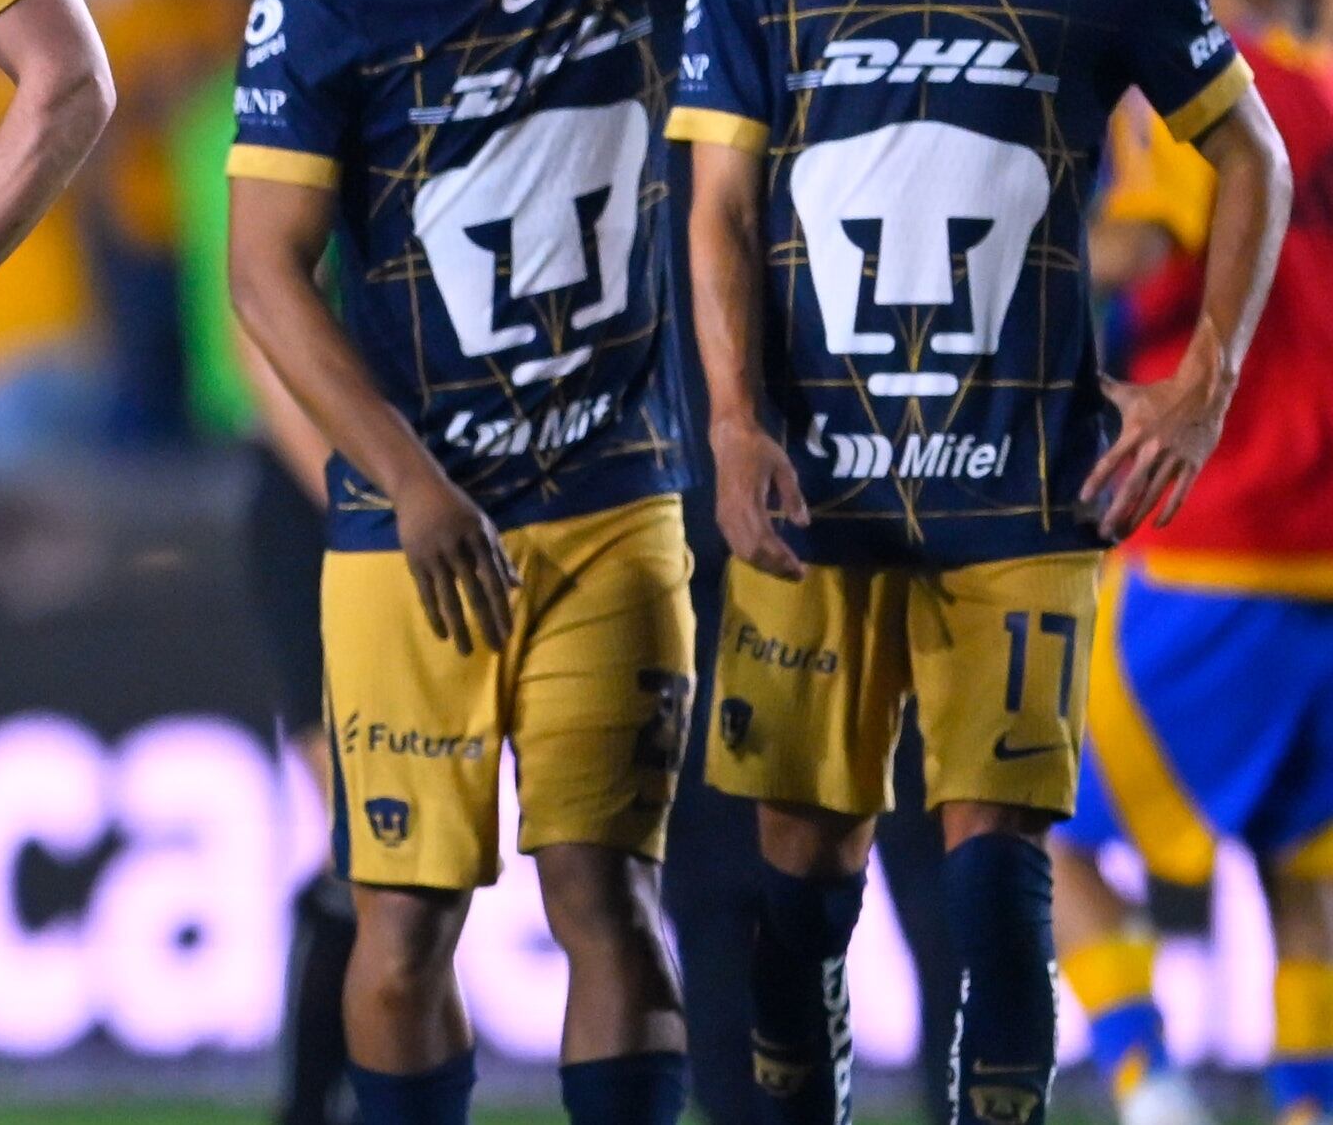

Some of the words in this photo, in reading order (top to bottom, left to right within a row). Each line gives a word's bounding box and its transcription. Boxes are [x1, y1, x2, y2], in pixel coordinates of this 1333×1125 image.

[821, 39, 1031, 85] DHL
[899, 433, 1012, 478] Mifel
[735, 623, 839, 674] Futura
[1004, 610, 1078, 717] 17
